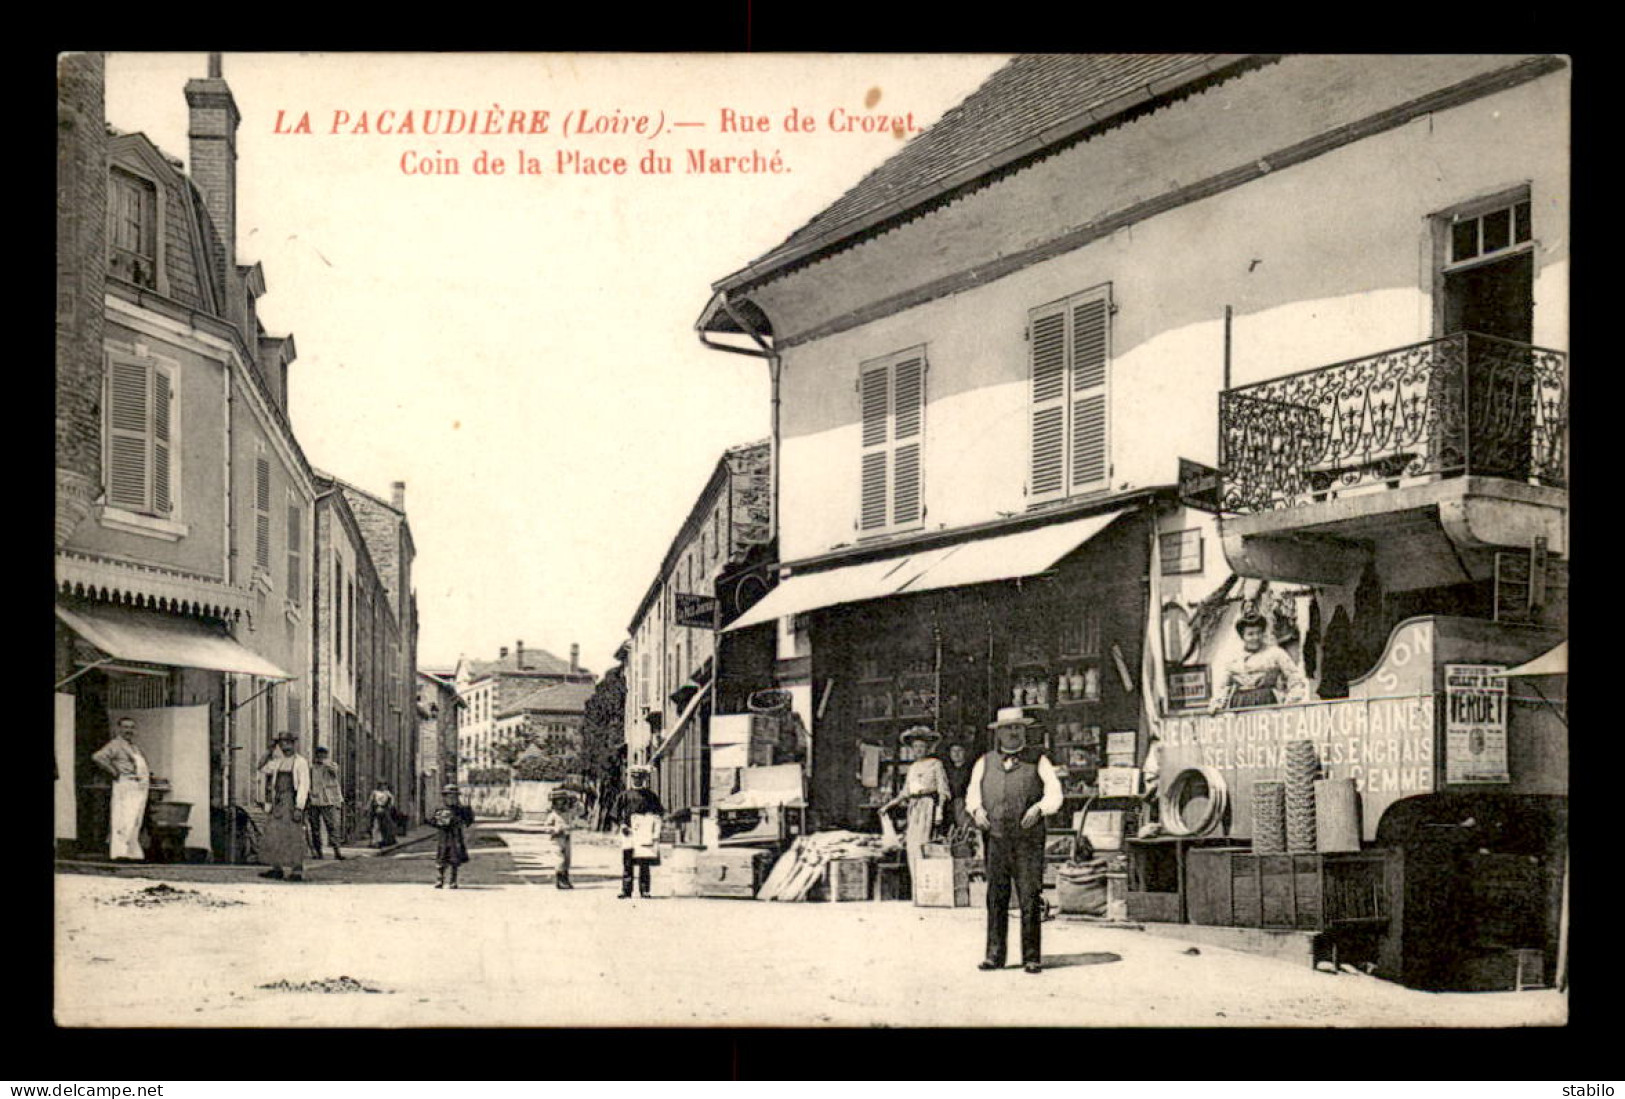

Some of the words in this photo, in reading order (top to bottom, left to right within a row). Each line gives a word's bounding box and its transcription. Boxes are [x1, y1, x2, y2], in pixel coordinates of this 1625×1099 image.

[1340, 699, 1432, 736] GRAINES
[1349, 736, 1432, 764] ENGRAIS
[1351, 765, 1431, 793] GEMME
